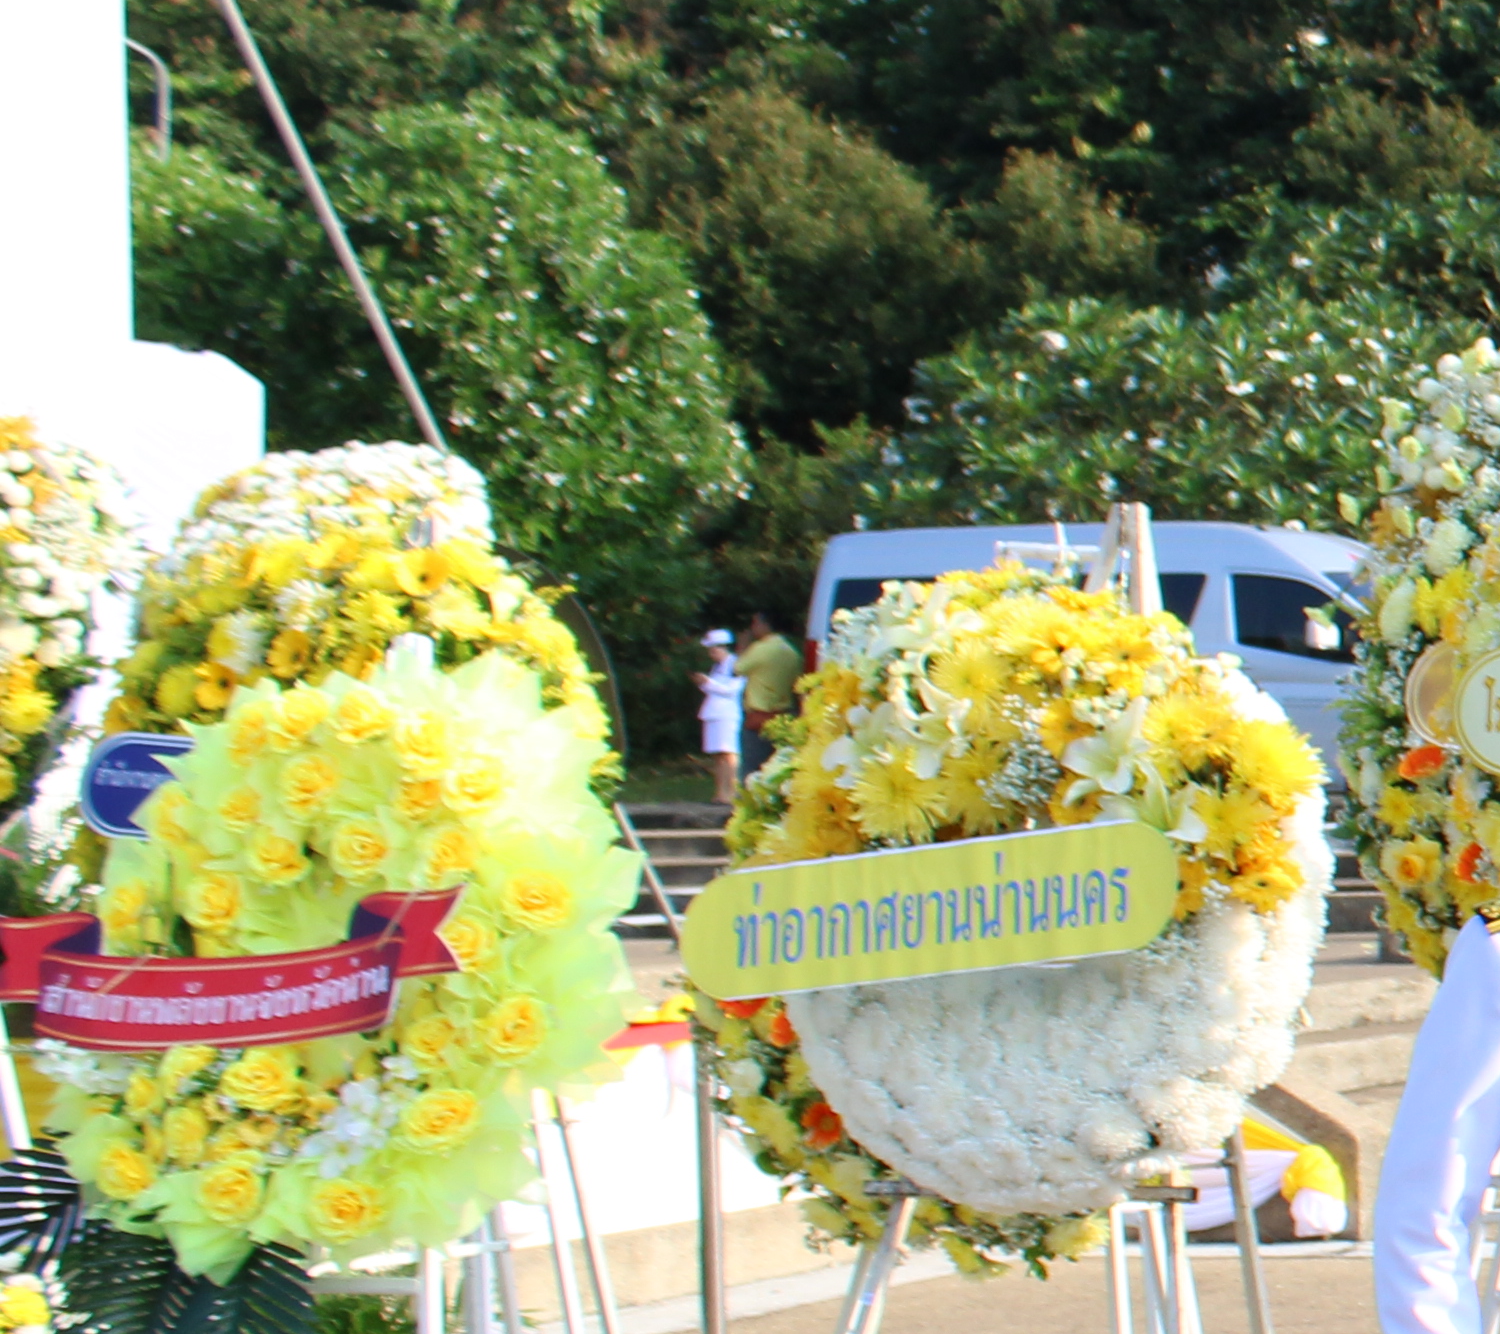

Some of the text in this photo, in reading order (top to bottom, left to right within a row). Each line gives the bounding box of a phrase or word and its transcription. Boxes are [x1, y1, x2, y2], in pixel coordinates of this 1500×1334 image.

[733, 851, 1130, 968] ท่าอากาศยานน่านนคร
